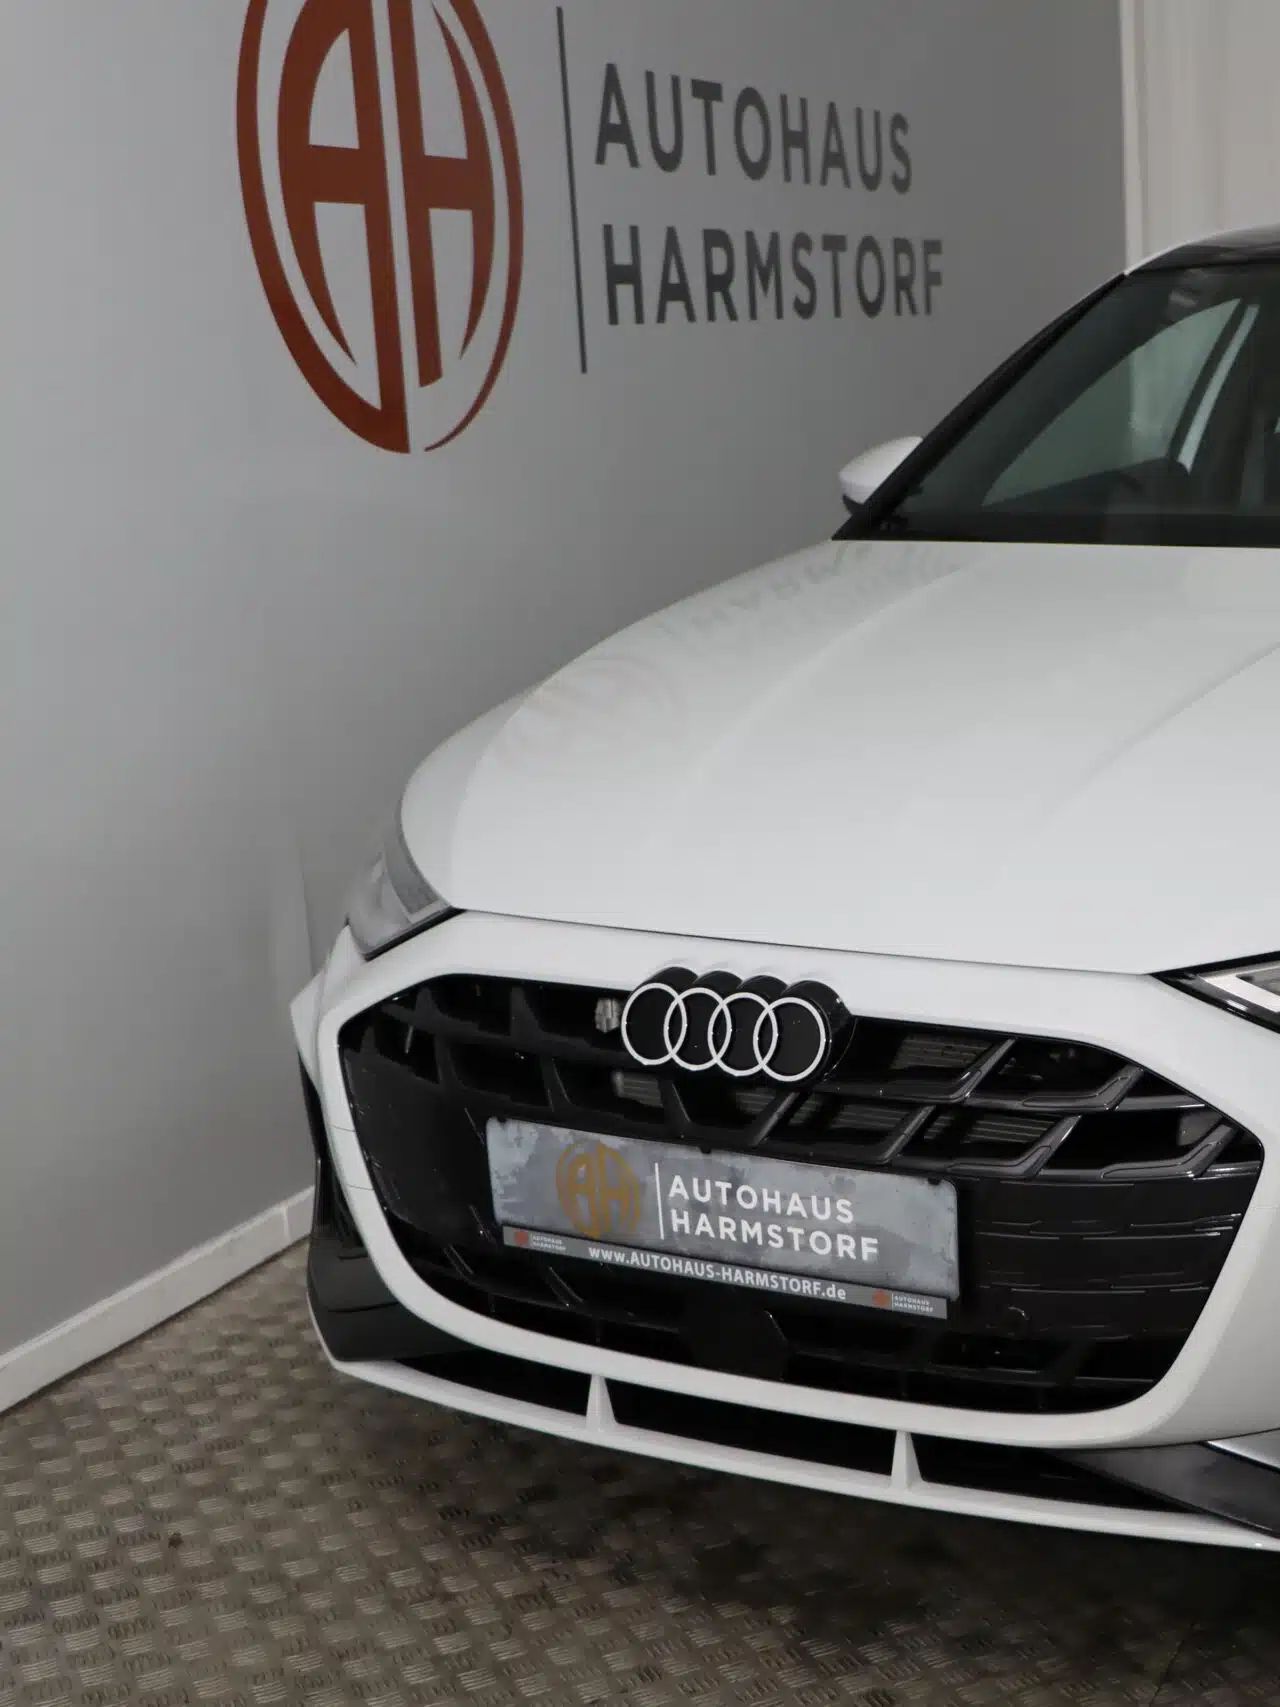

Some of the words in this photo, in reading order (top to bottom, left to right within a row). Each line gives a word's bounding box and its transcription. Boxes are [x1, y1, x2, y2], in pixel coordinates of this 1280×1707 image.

[595, 62, 912, 195] AUTOHAUS
[602, 222, 943, 326] HARMSTORF
[668, 1174, 854, 1225] AUTOHAUS
[671, 1208, 879, 1261] HARMSTORF
[588, 1246, 847, 1301] www.AUTOHAUS-HARMSTORF.de
